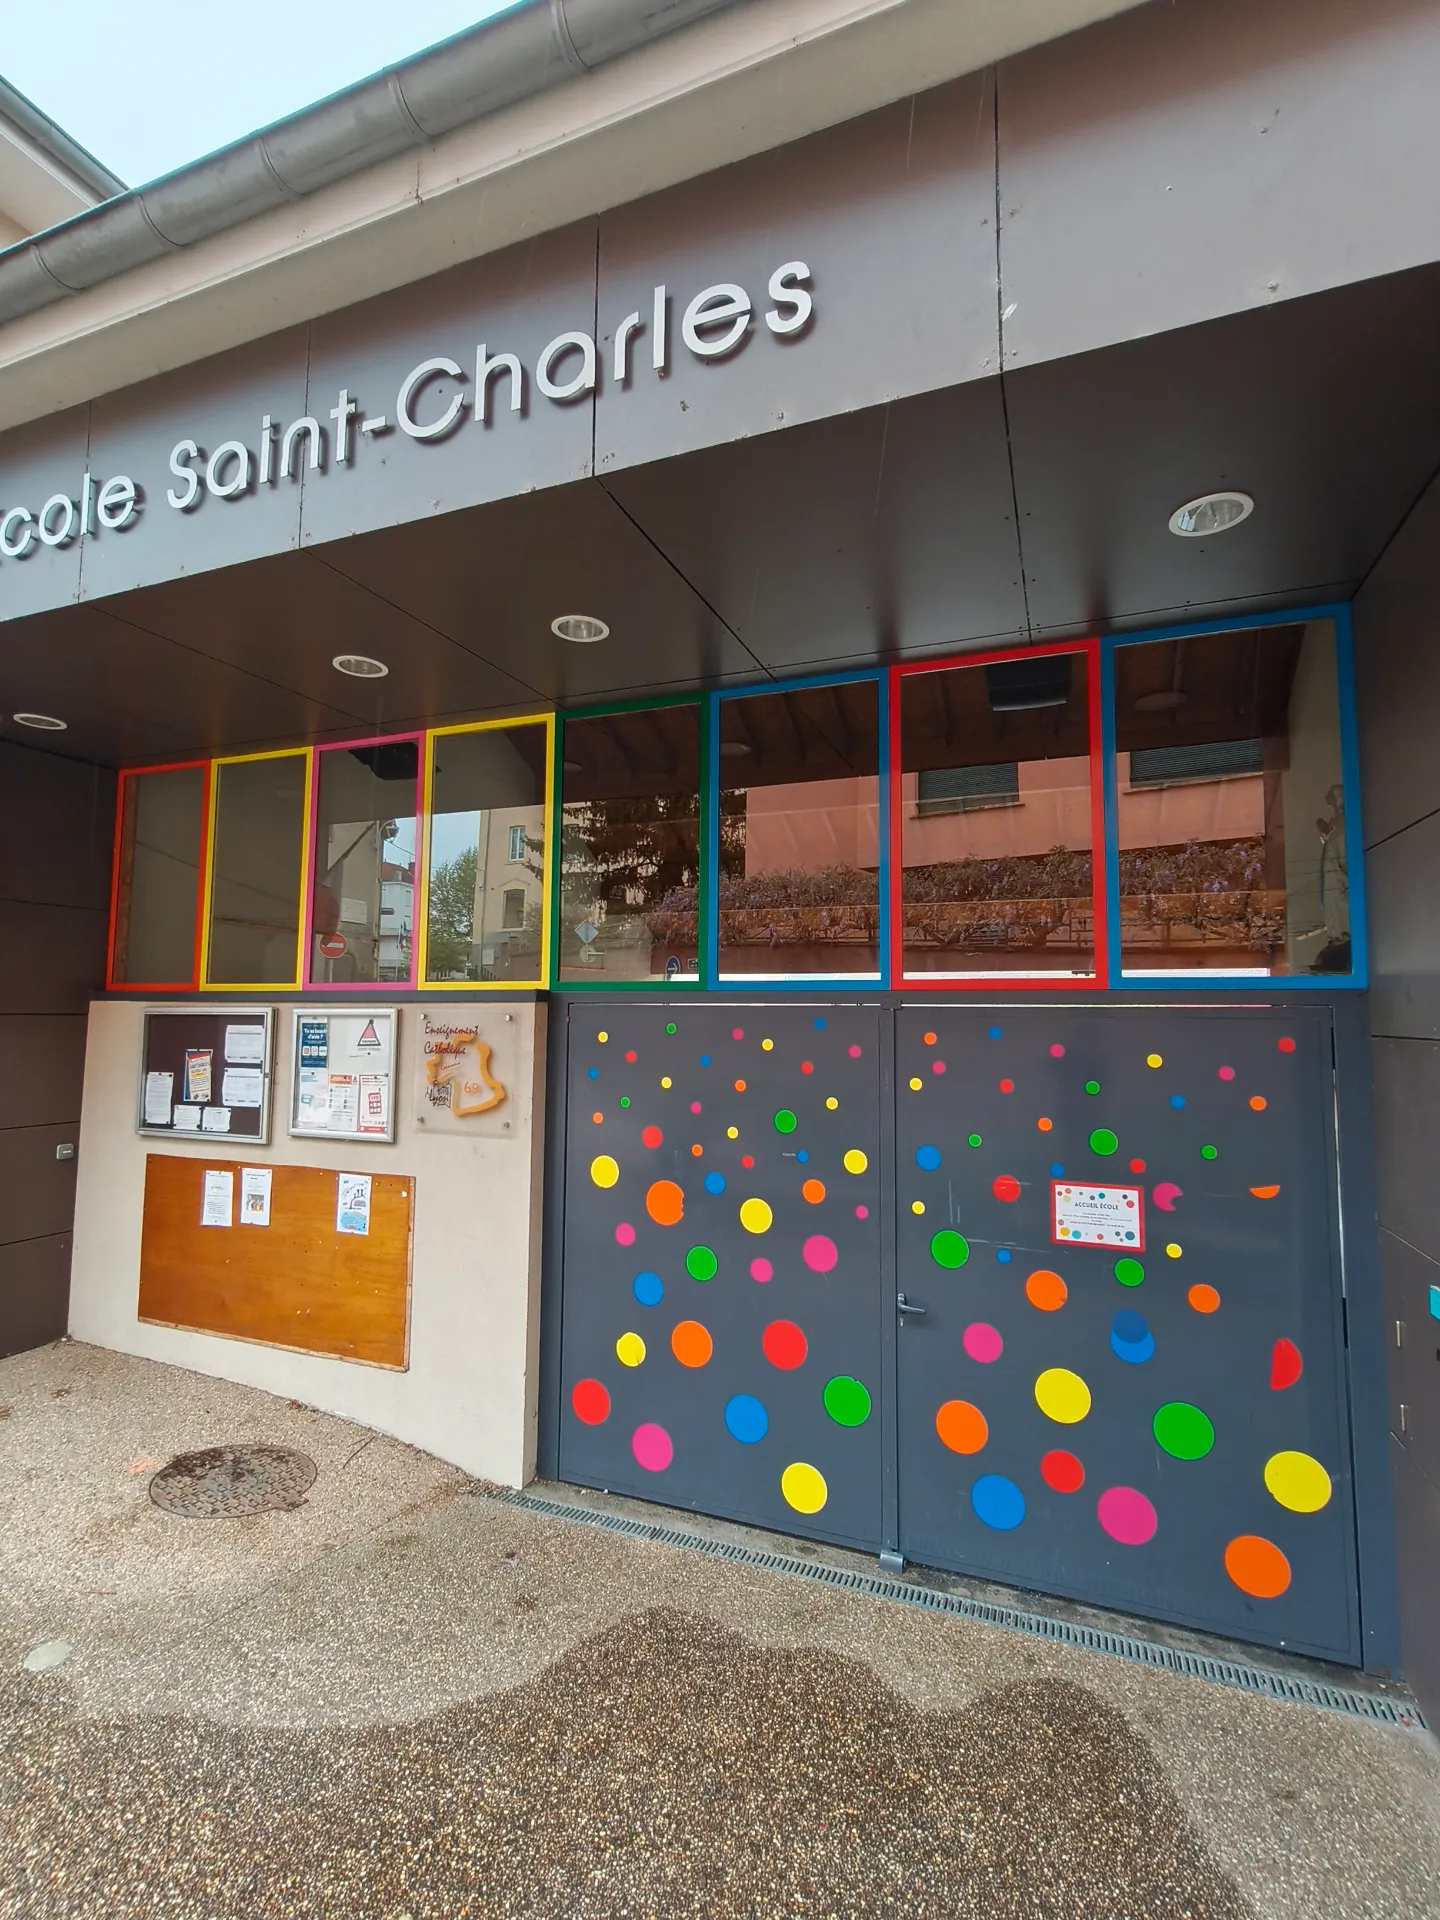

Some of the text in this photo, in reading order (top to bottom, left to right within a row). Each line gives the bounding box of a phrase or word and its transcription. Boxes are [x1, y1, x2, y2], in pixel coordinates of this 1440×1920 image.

[0, 260, 814, 557] cole Saint-Charles
[425, 1021, 480, 1039] Enseignement
[424, 1041, 467, 1059] Catholique
[464, 1081, 480, 1096] 69
